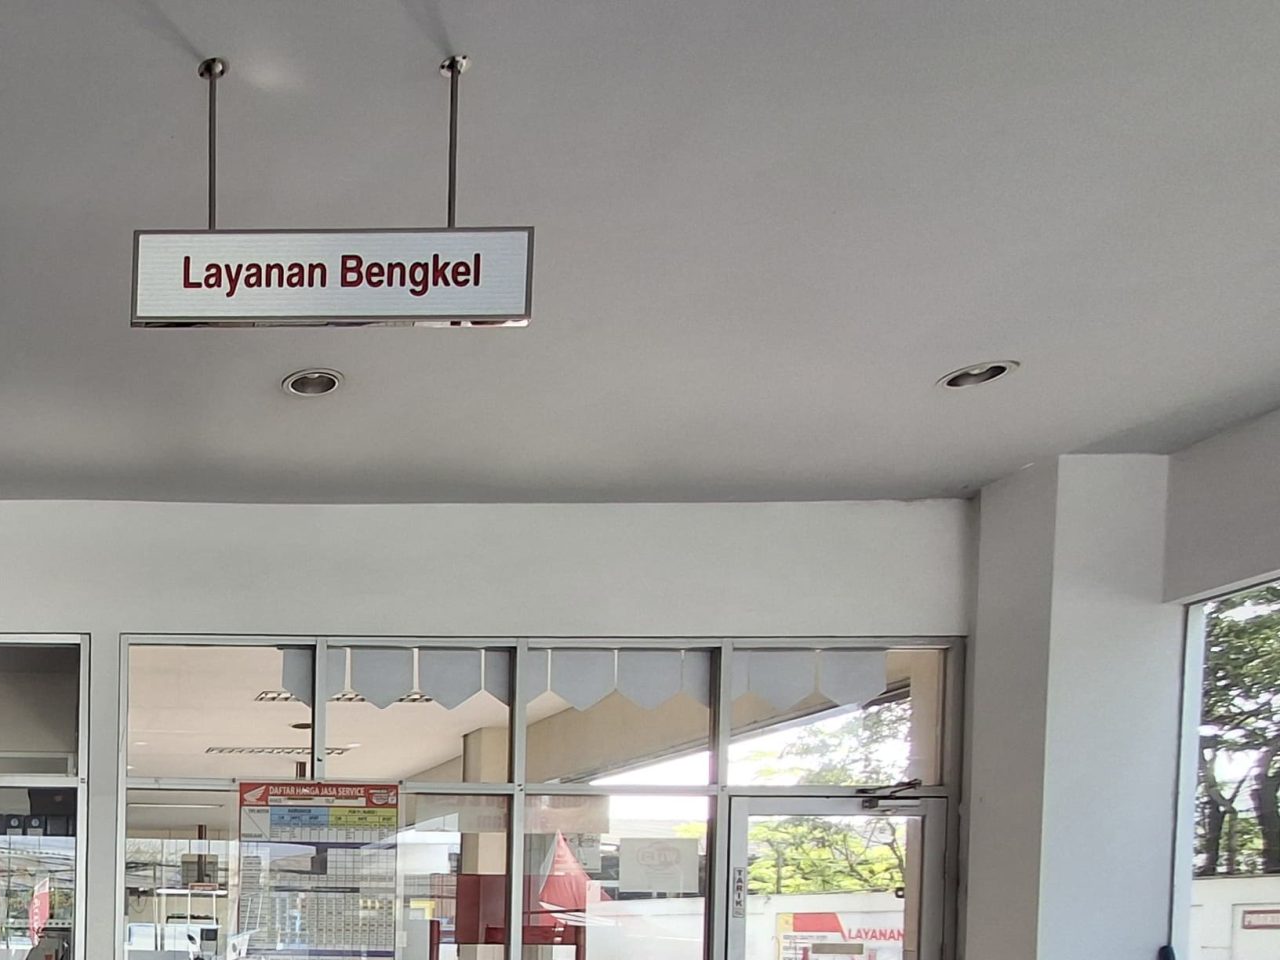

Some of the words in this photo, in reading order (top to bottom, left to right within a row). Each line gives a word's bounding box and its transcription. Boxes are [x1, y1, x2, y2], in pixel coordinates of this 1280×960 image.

[182, 255, 327, 297] Layanan
[339, 253, 481, 296] Bengkel
[269, 786, 295, 795] DAFTAR
[321, 786, 337, 796] JASA
[338, 787, 365, 797] SERVICE
[735, 869, 744, 907] TARIK
